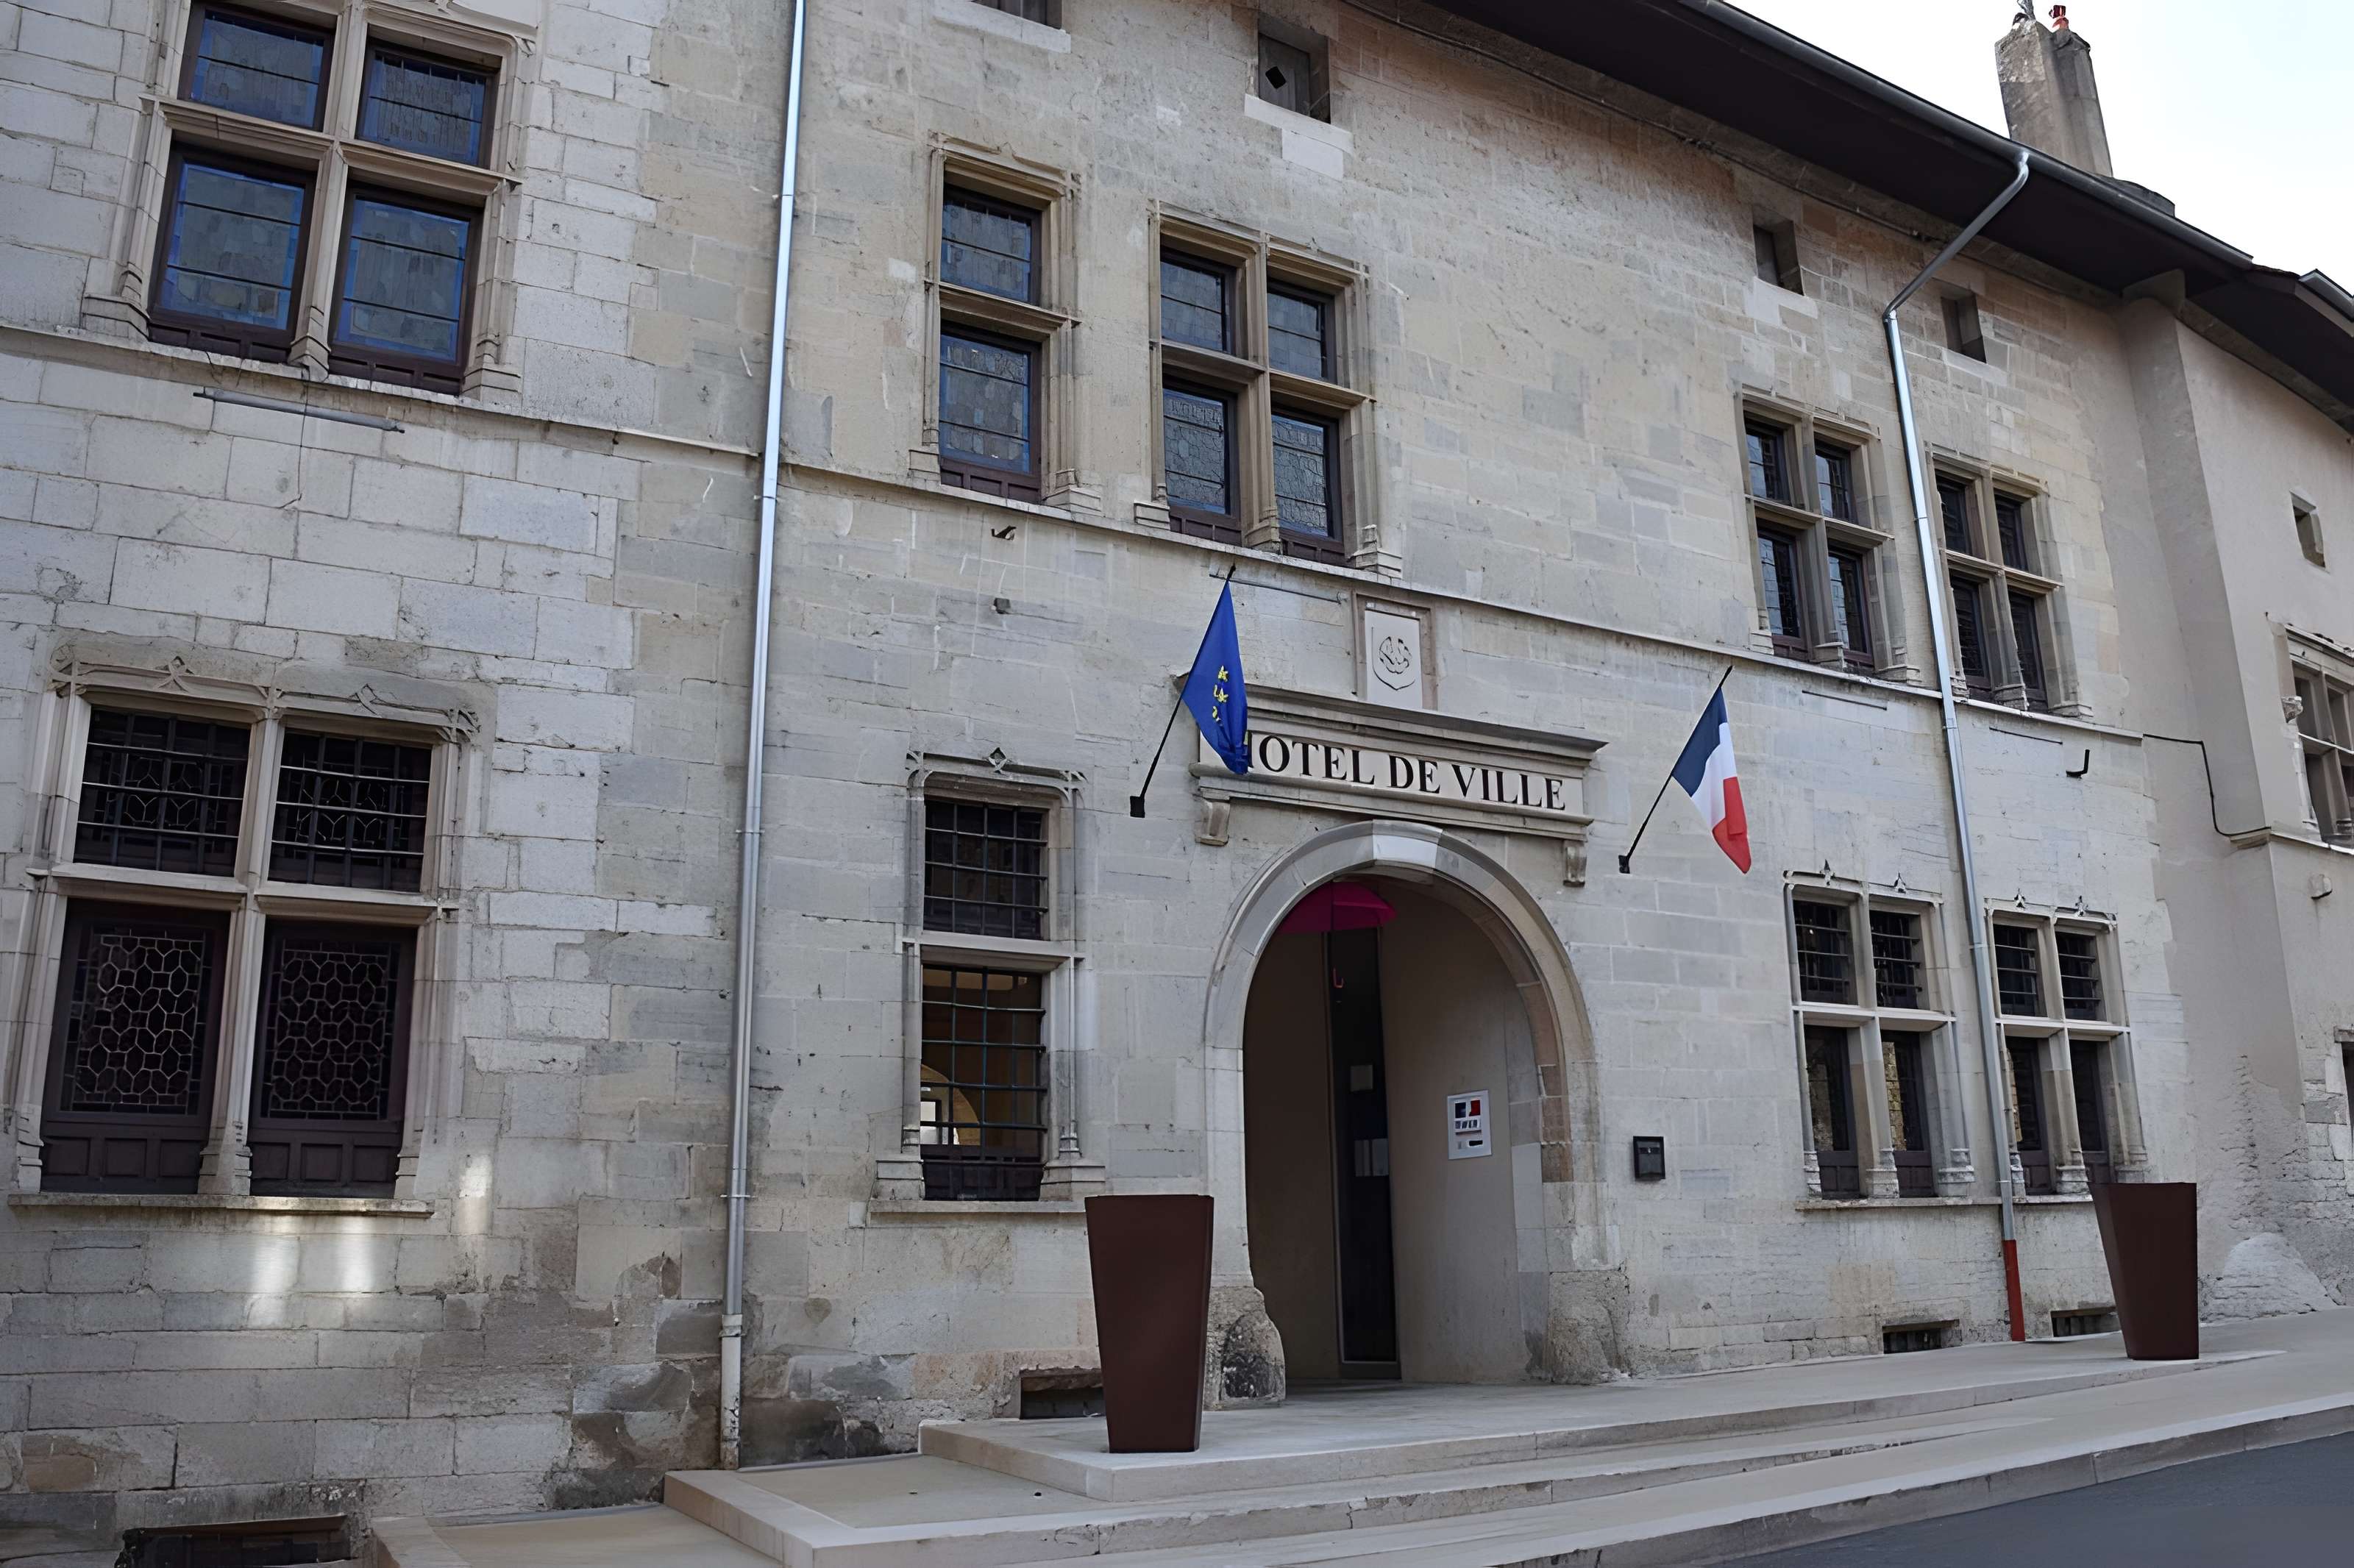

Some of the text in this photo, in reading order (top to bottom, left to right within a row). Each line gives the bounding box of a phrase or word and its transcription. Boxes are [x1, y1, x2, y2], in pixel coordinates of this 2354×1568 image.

[1247, 730, 1566, 810] OTEL DE VILLE
